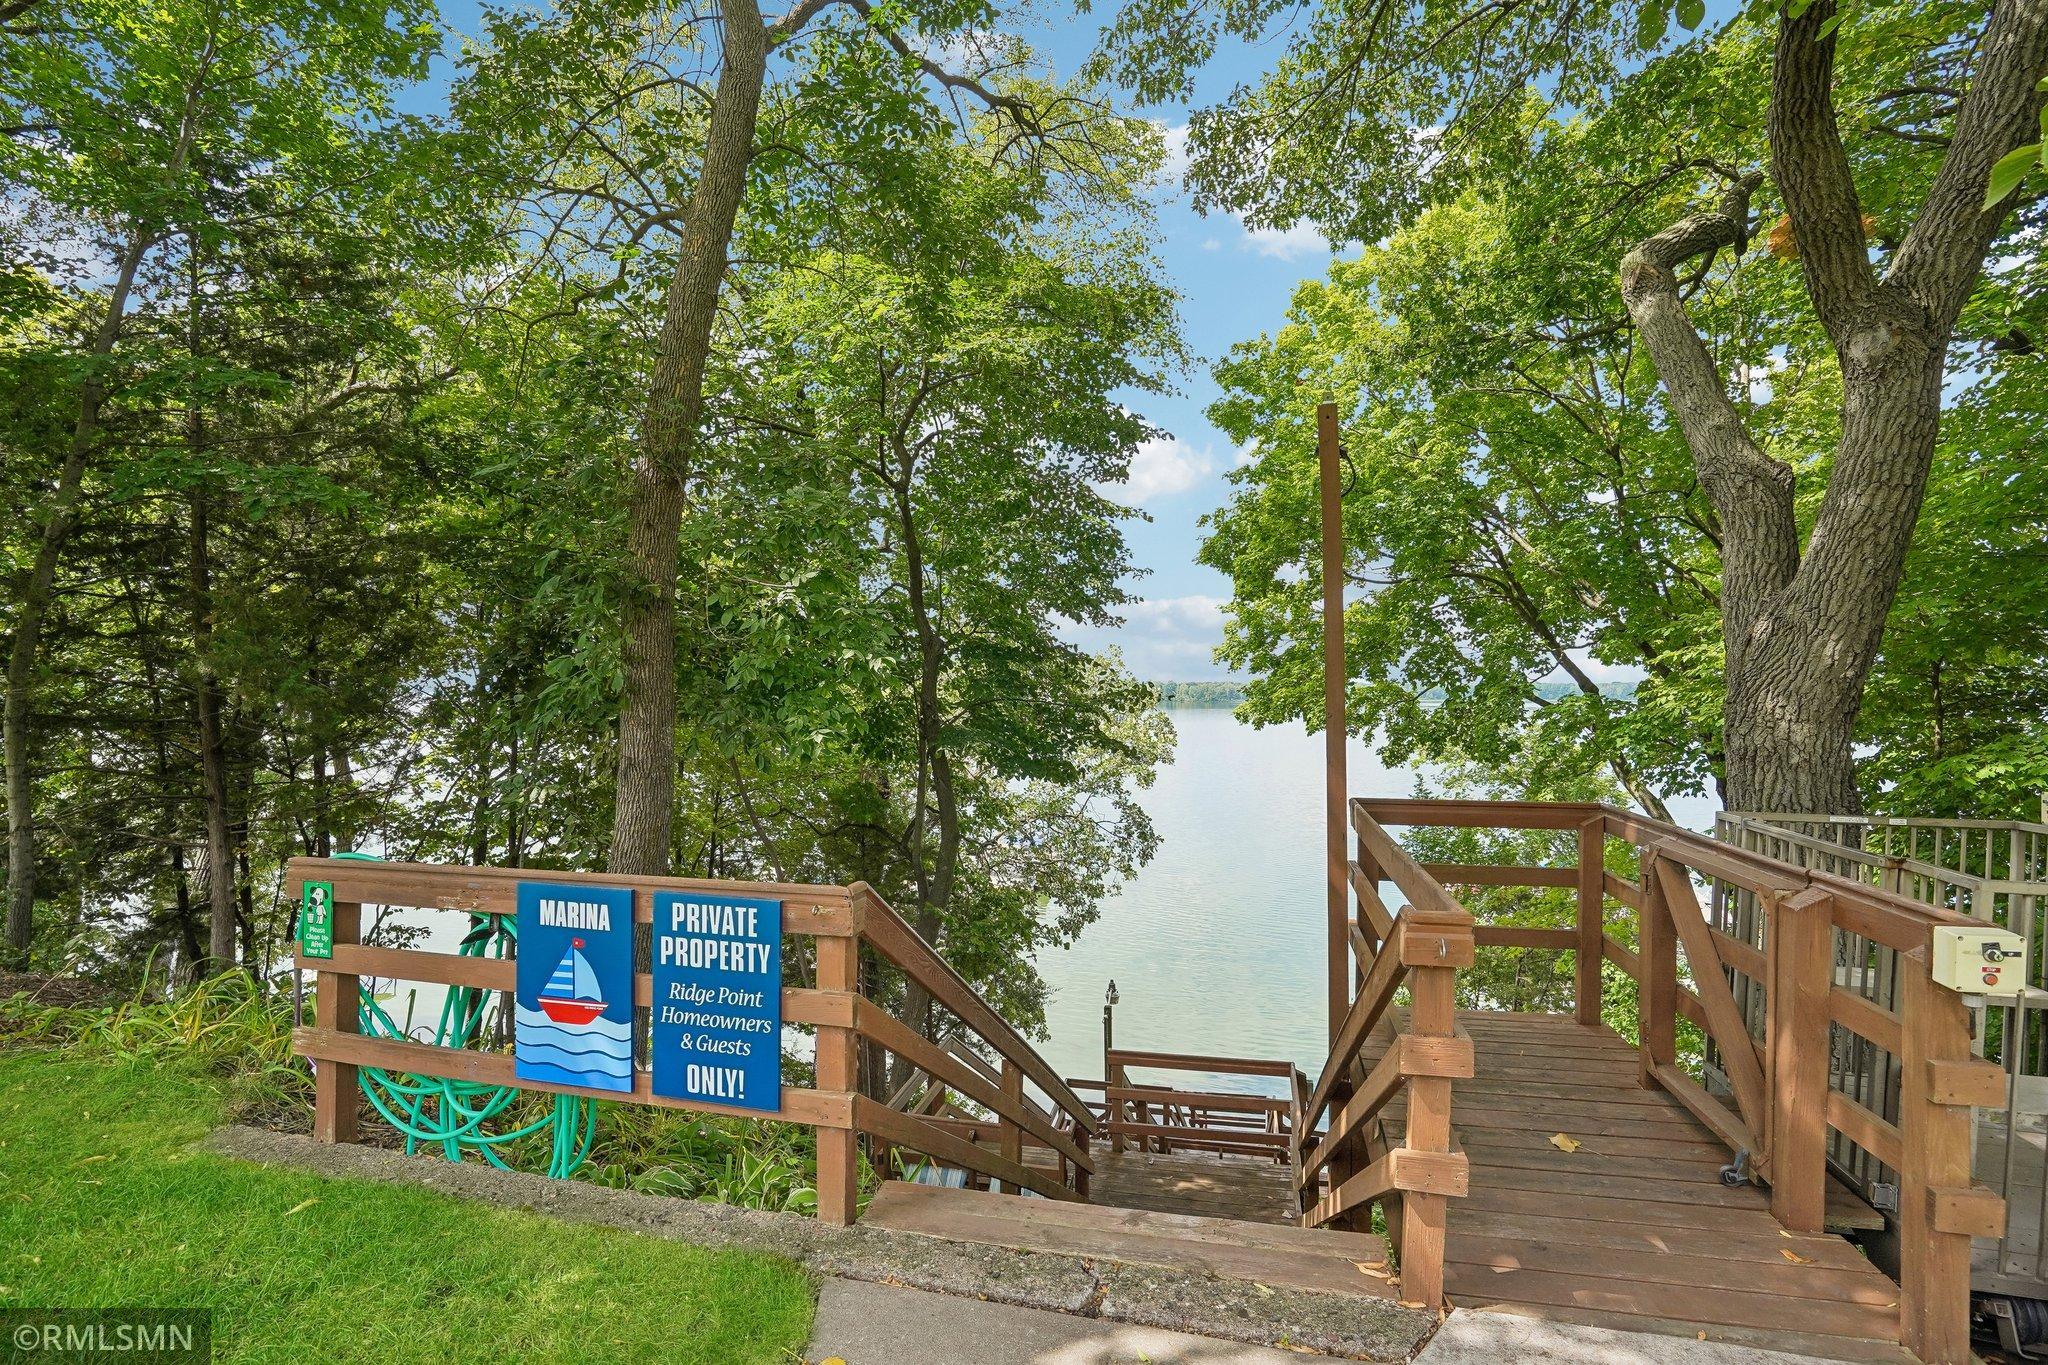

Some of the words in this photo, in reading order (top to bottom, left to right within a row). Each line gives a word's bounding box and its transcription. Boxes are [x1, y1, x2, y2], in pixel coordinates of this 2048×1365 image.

[309, 926, 325, 934] Please
[539, 899, 611, 932] MARINA
[672, 902, 758, 938] PRIVATE
[660, 936, 771, 974] PROPERTY
[669, 982, 715, 1006] Ridge
[718, 987, 764, 1008] Point
[661, 1006, 772, 1034] Homeowners
[680, 1033, 694, 1050] &
[696, 1035, 751, 1056] Guests
[687, 1063, 745, 1100] ONLY!
